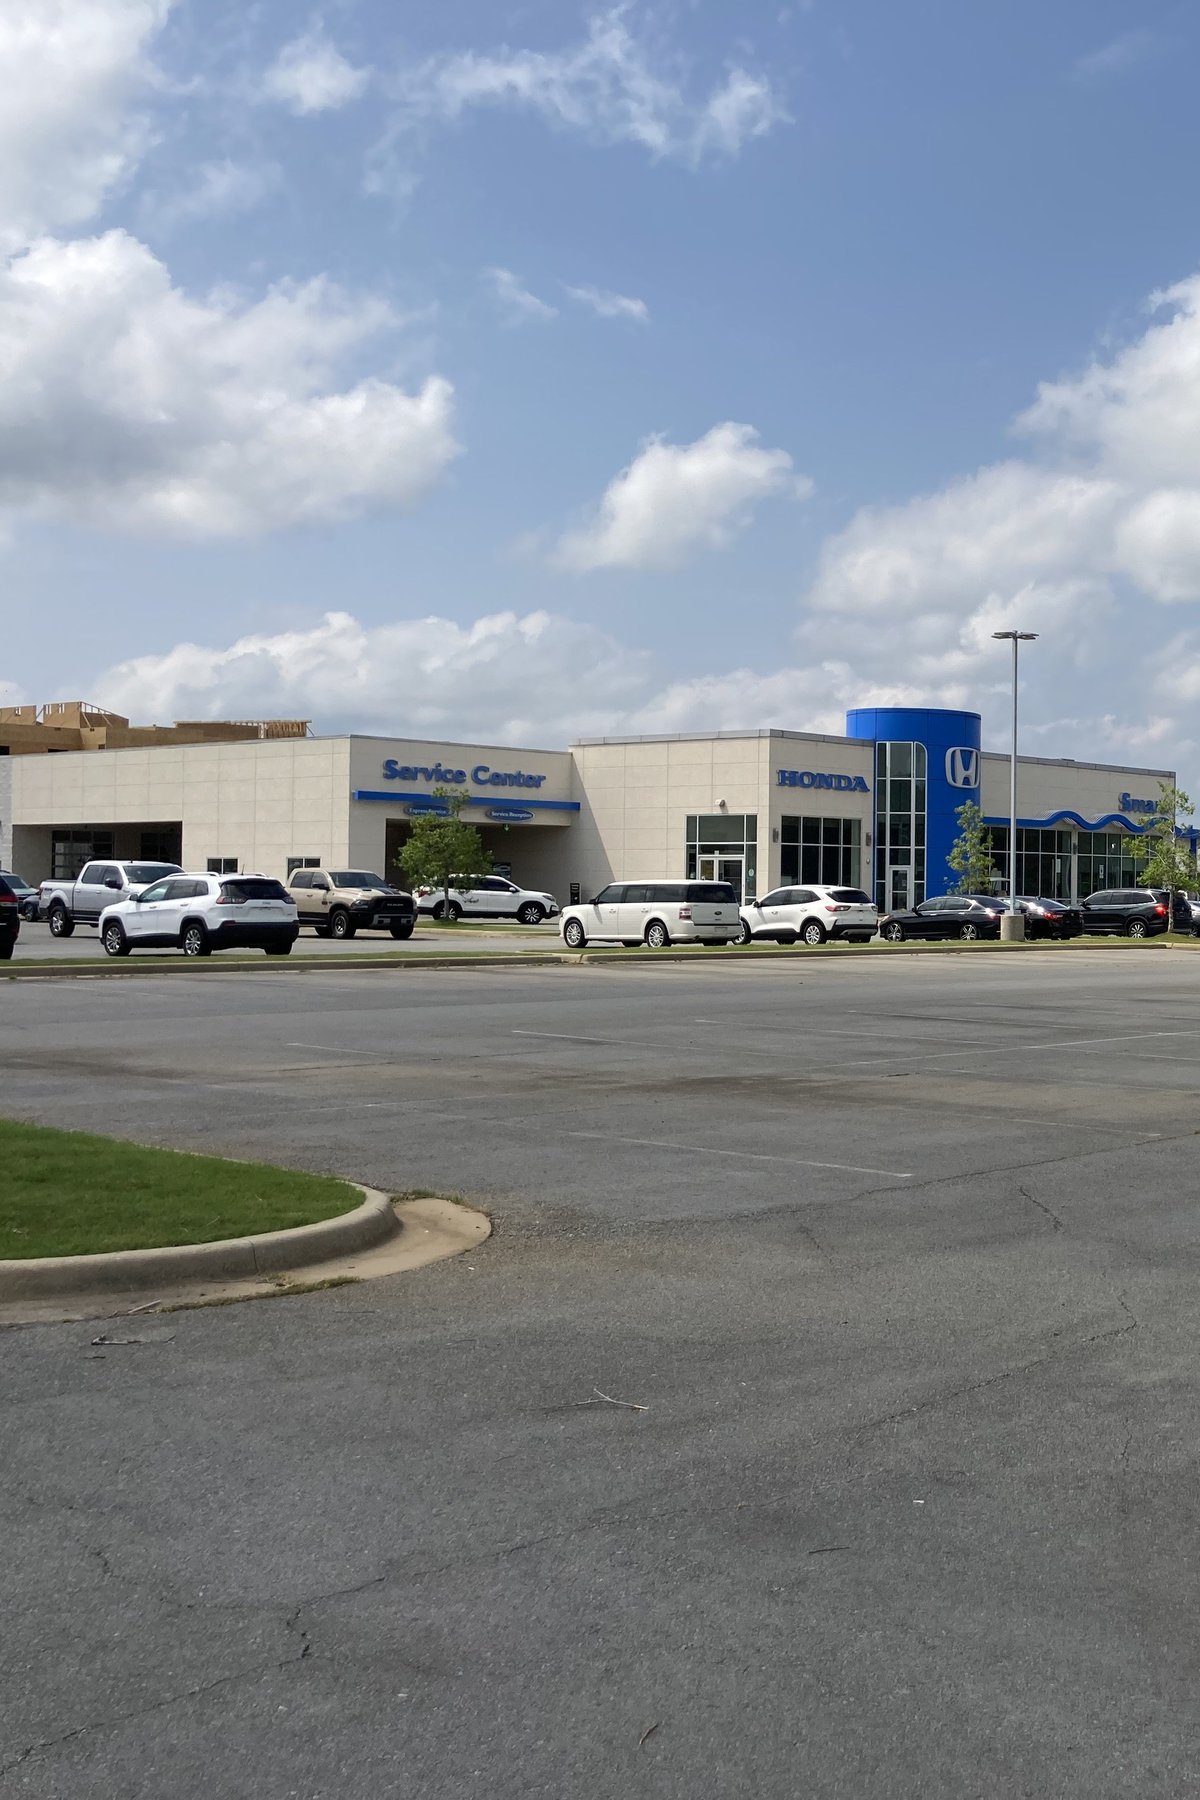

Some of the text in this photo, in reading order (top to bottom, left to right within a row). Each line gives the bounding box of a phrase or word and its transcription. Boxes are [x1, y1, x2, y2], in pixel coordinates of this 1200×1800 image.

[383, 759, 547, 788] Service Center
[776, 769, 870, 792] HONDA
